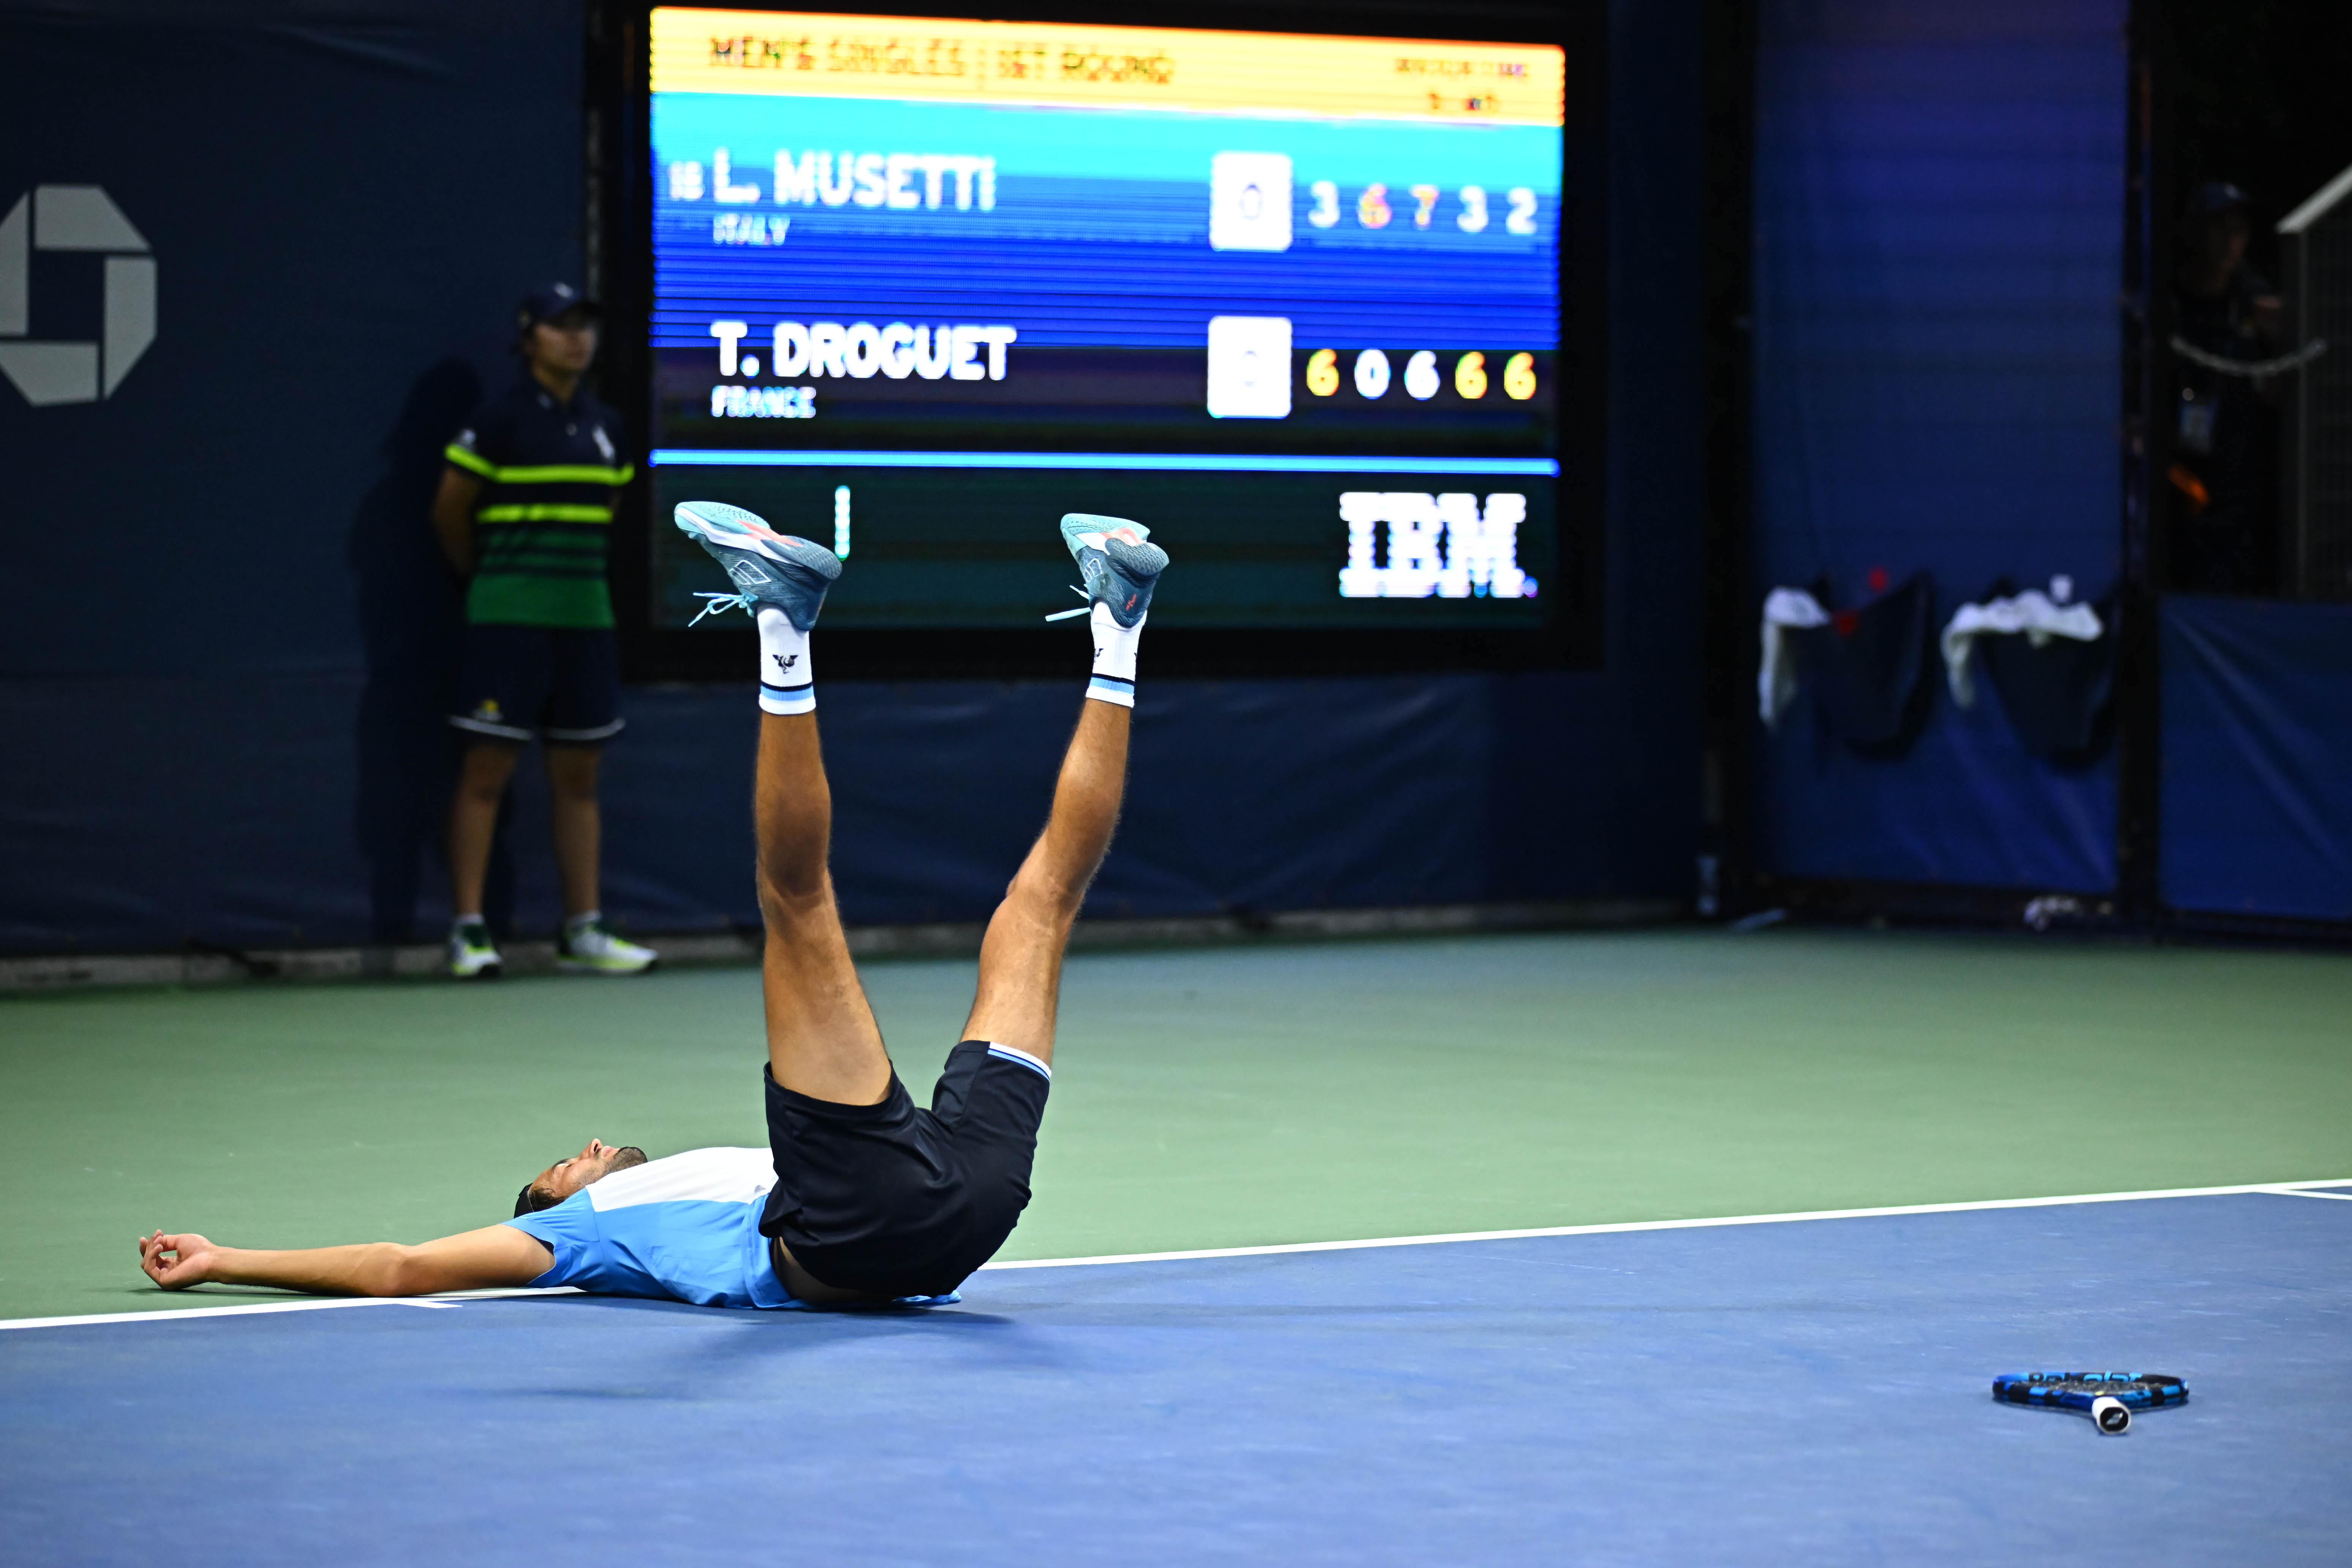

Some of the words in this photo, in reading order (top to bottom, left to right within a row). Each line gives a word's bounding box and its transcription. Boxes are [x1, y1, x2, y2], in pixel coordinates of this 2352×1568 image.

[826, 38, 966, 77] SINGLES
[775, 149, 996, 212] MUSETTI
[1308, 180, 1340, 229] 3
[1358, 183, 1392, 229] 6
[1409, 184, 1439, 230] 7
[1457, 185, 1488, 234] 3
[1506, 187, 1537, 236] 2
[710, 320, 760, 377] T.
[773, 321, 1017, 380] DROGUET
[1307, 348, 1339, 396] 6
[1354, 349, 1391, 399] 0
[1404, 350, 1440, 400] 6
[1455, 351, 1487, 399] 6
[1503, 352, 1536, 400] 6
[711, 385, 816, 418] FRANCE
[1339, 492, 1526, 598] IBM
